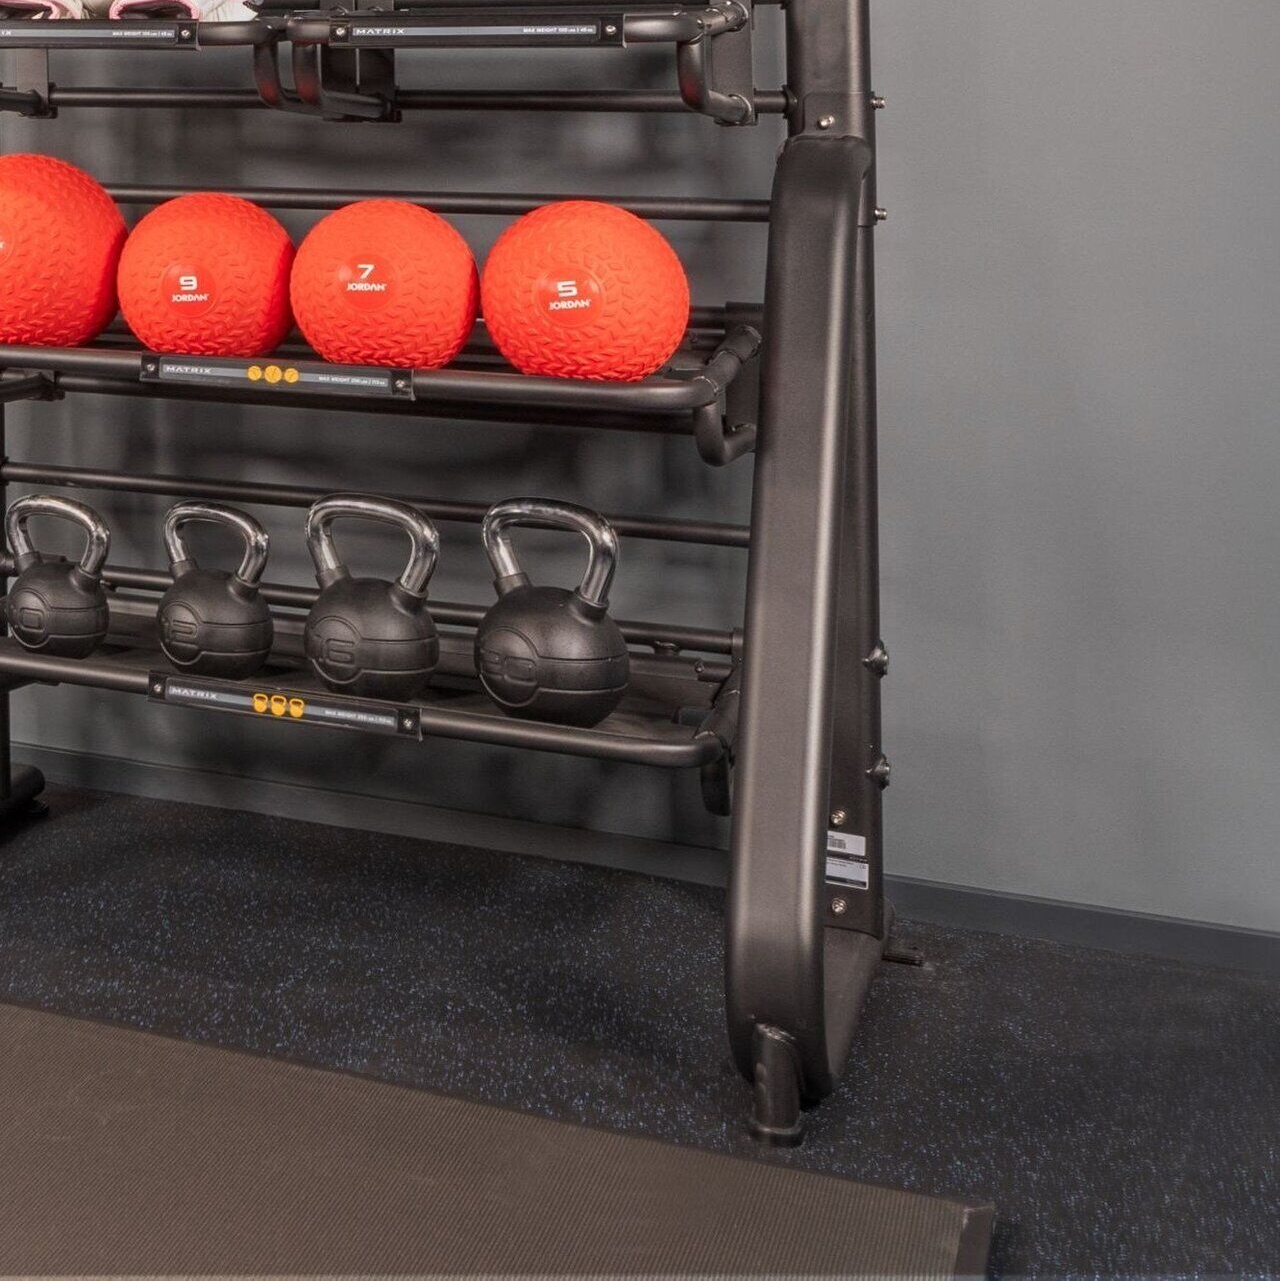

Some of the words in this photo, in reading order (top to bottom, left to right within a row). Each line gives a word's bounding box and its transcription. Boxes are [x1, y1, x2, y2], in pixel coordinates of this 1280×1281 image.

[357, 263, 375, 279] 7
[179, 275, 198, 291] 9
[346, 282, 387, 292] JORDAN
[557, 280, 578, 298] 5
[171, 293, 209, 303] JORDAN
[548, 299, 591, 311] JORDAN
[165, 366, 212, 374] MATRIX
[171, 686, 219, 700] MATRIX
